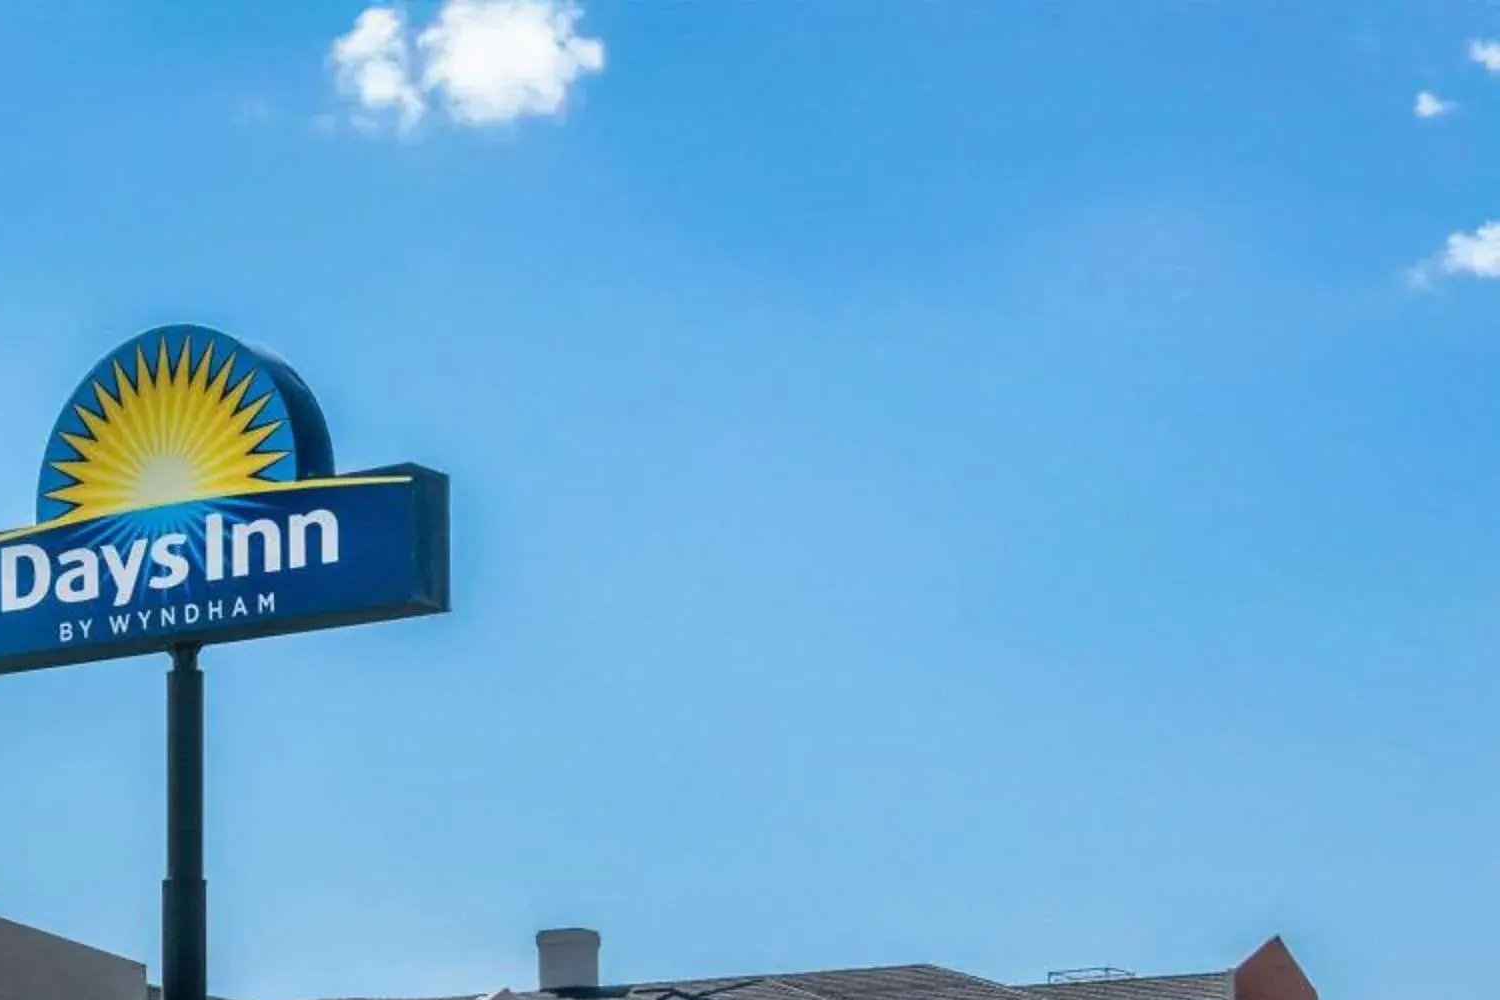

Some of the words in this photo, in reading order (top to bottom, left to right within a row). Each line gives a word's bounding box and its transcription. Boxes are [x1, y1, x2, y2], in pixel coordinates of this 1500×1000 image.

[0, 533, 189, 612] Days
[205, 508, 339, 581] Inn
[59, 619, 92, 642] BY
[110, 592, 276, 634] WYNDHAM
